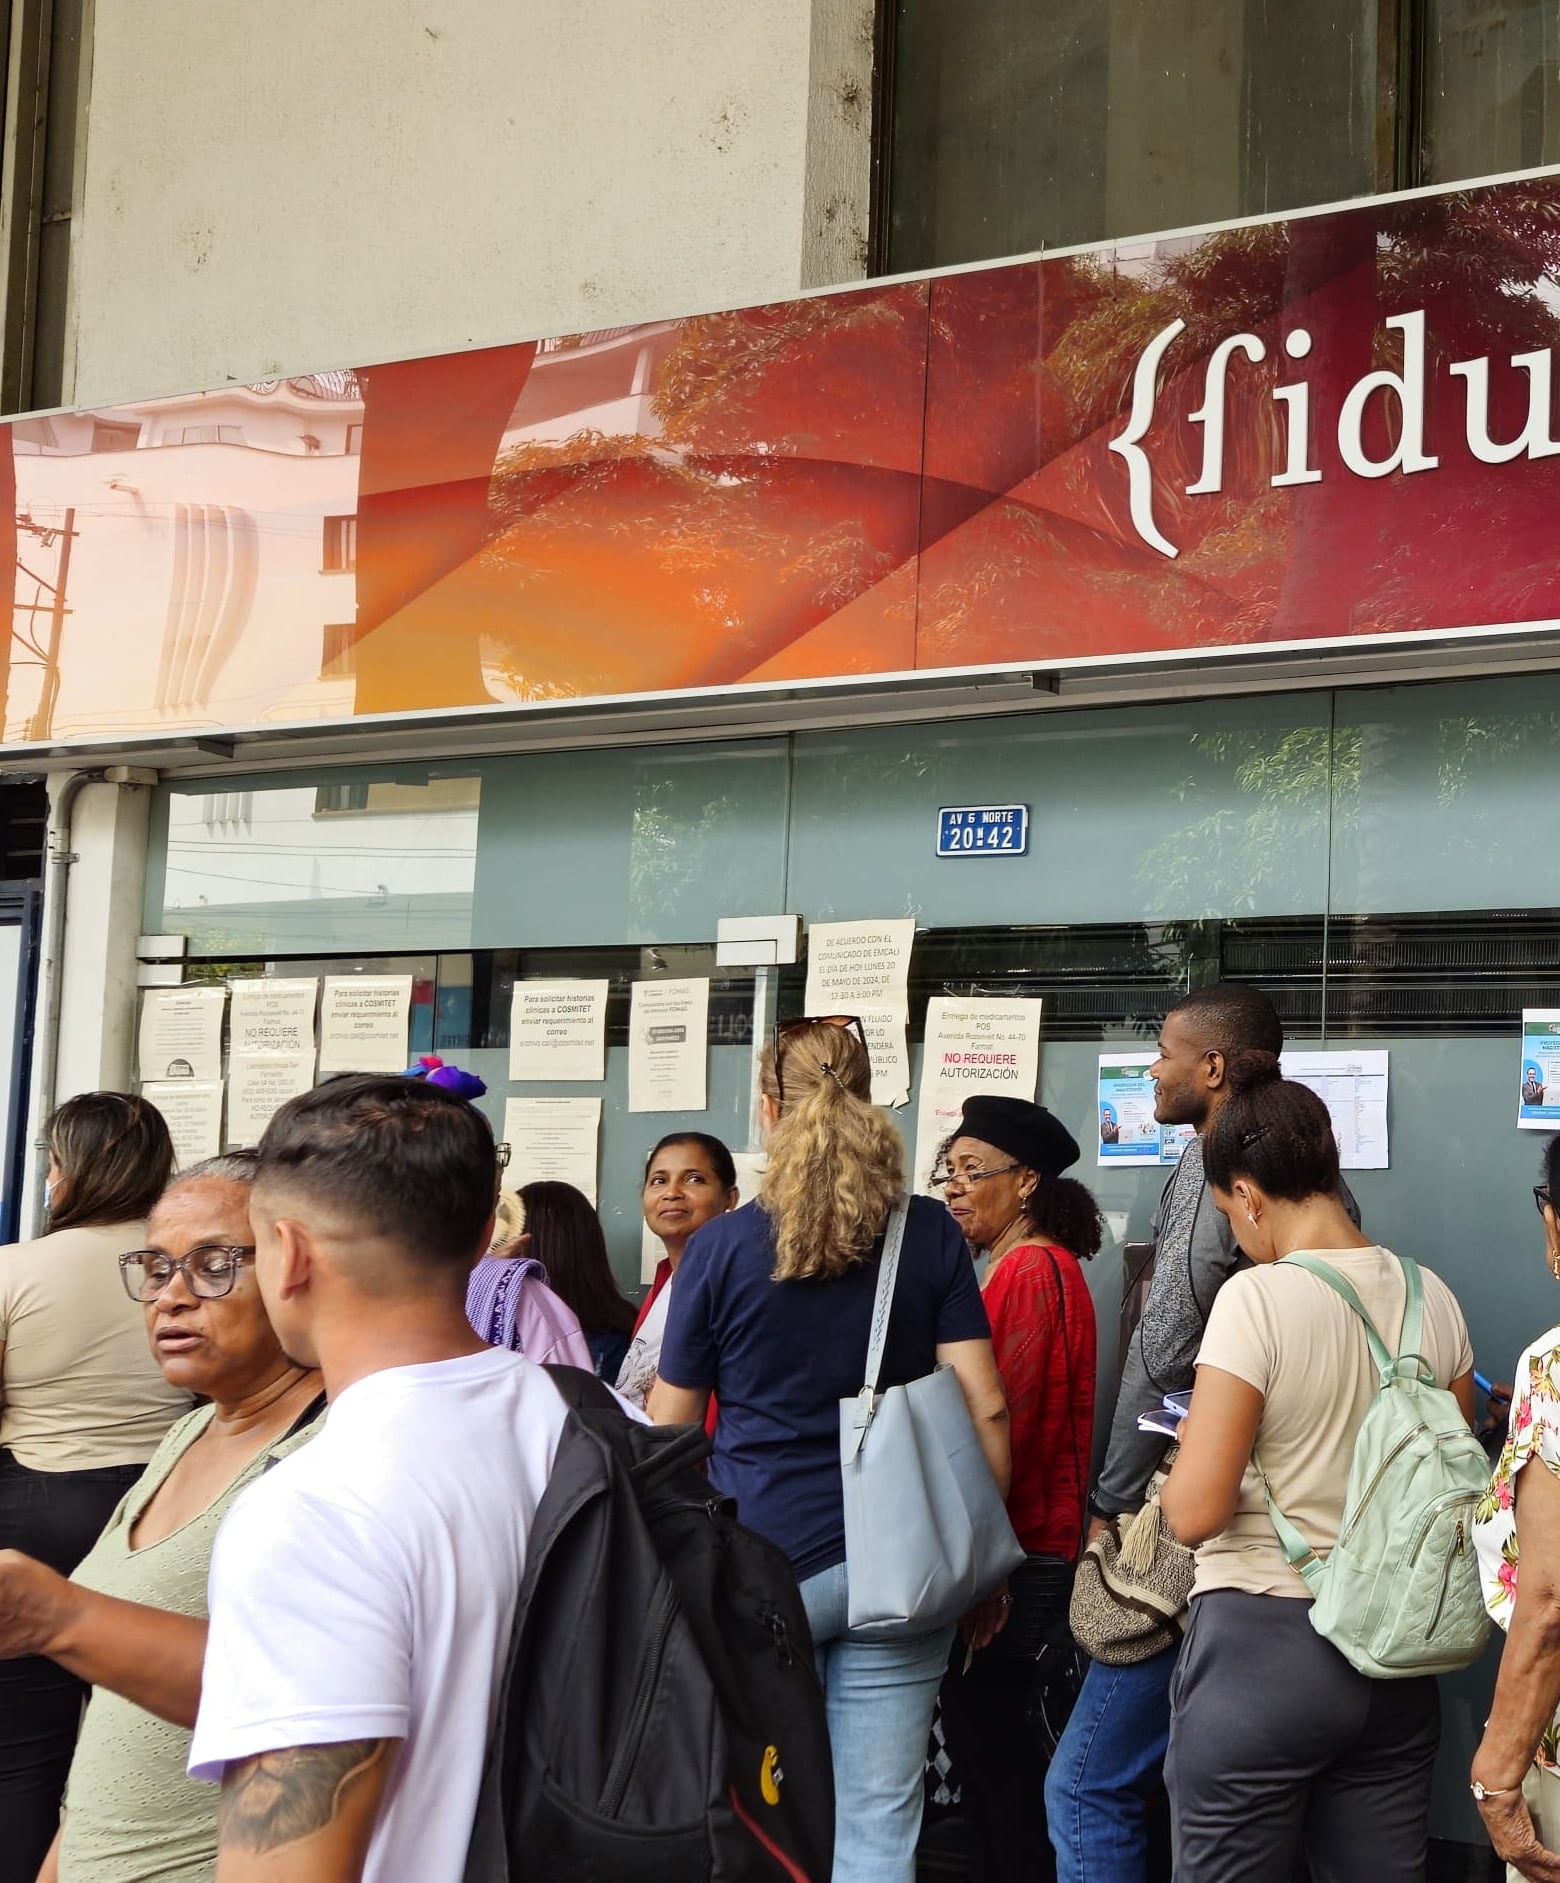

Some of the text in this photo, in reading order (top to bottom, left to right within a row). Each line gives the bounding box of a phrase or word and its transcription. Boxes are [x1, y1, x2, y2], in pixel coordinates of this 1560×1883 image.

[949, 811, 1014, 825] AV 6 NORTE
[836, 936, 867, 946] ACUERDO
[867, 935, 882, 944] CON
[818, 950, 862, 961] COMUNICADO
[850, 963, 864, 972] HOY
[864, 961, 886, 971] LUNES
[832, 977, 851, 987] MAYO
[524, 995, 539, 1003] Para
[556, 1004, 592, 1013] COSMITET
[245, 1026, 299, 1038] NO REQUIERE
[976, 1022, 991, 1031] POS
[944, 1052, 1017, 1065] NO REQUIERE
[940, 1066, 1019, 1080] AUTORIZACIÓN
